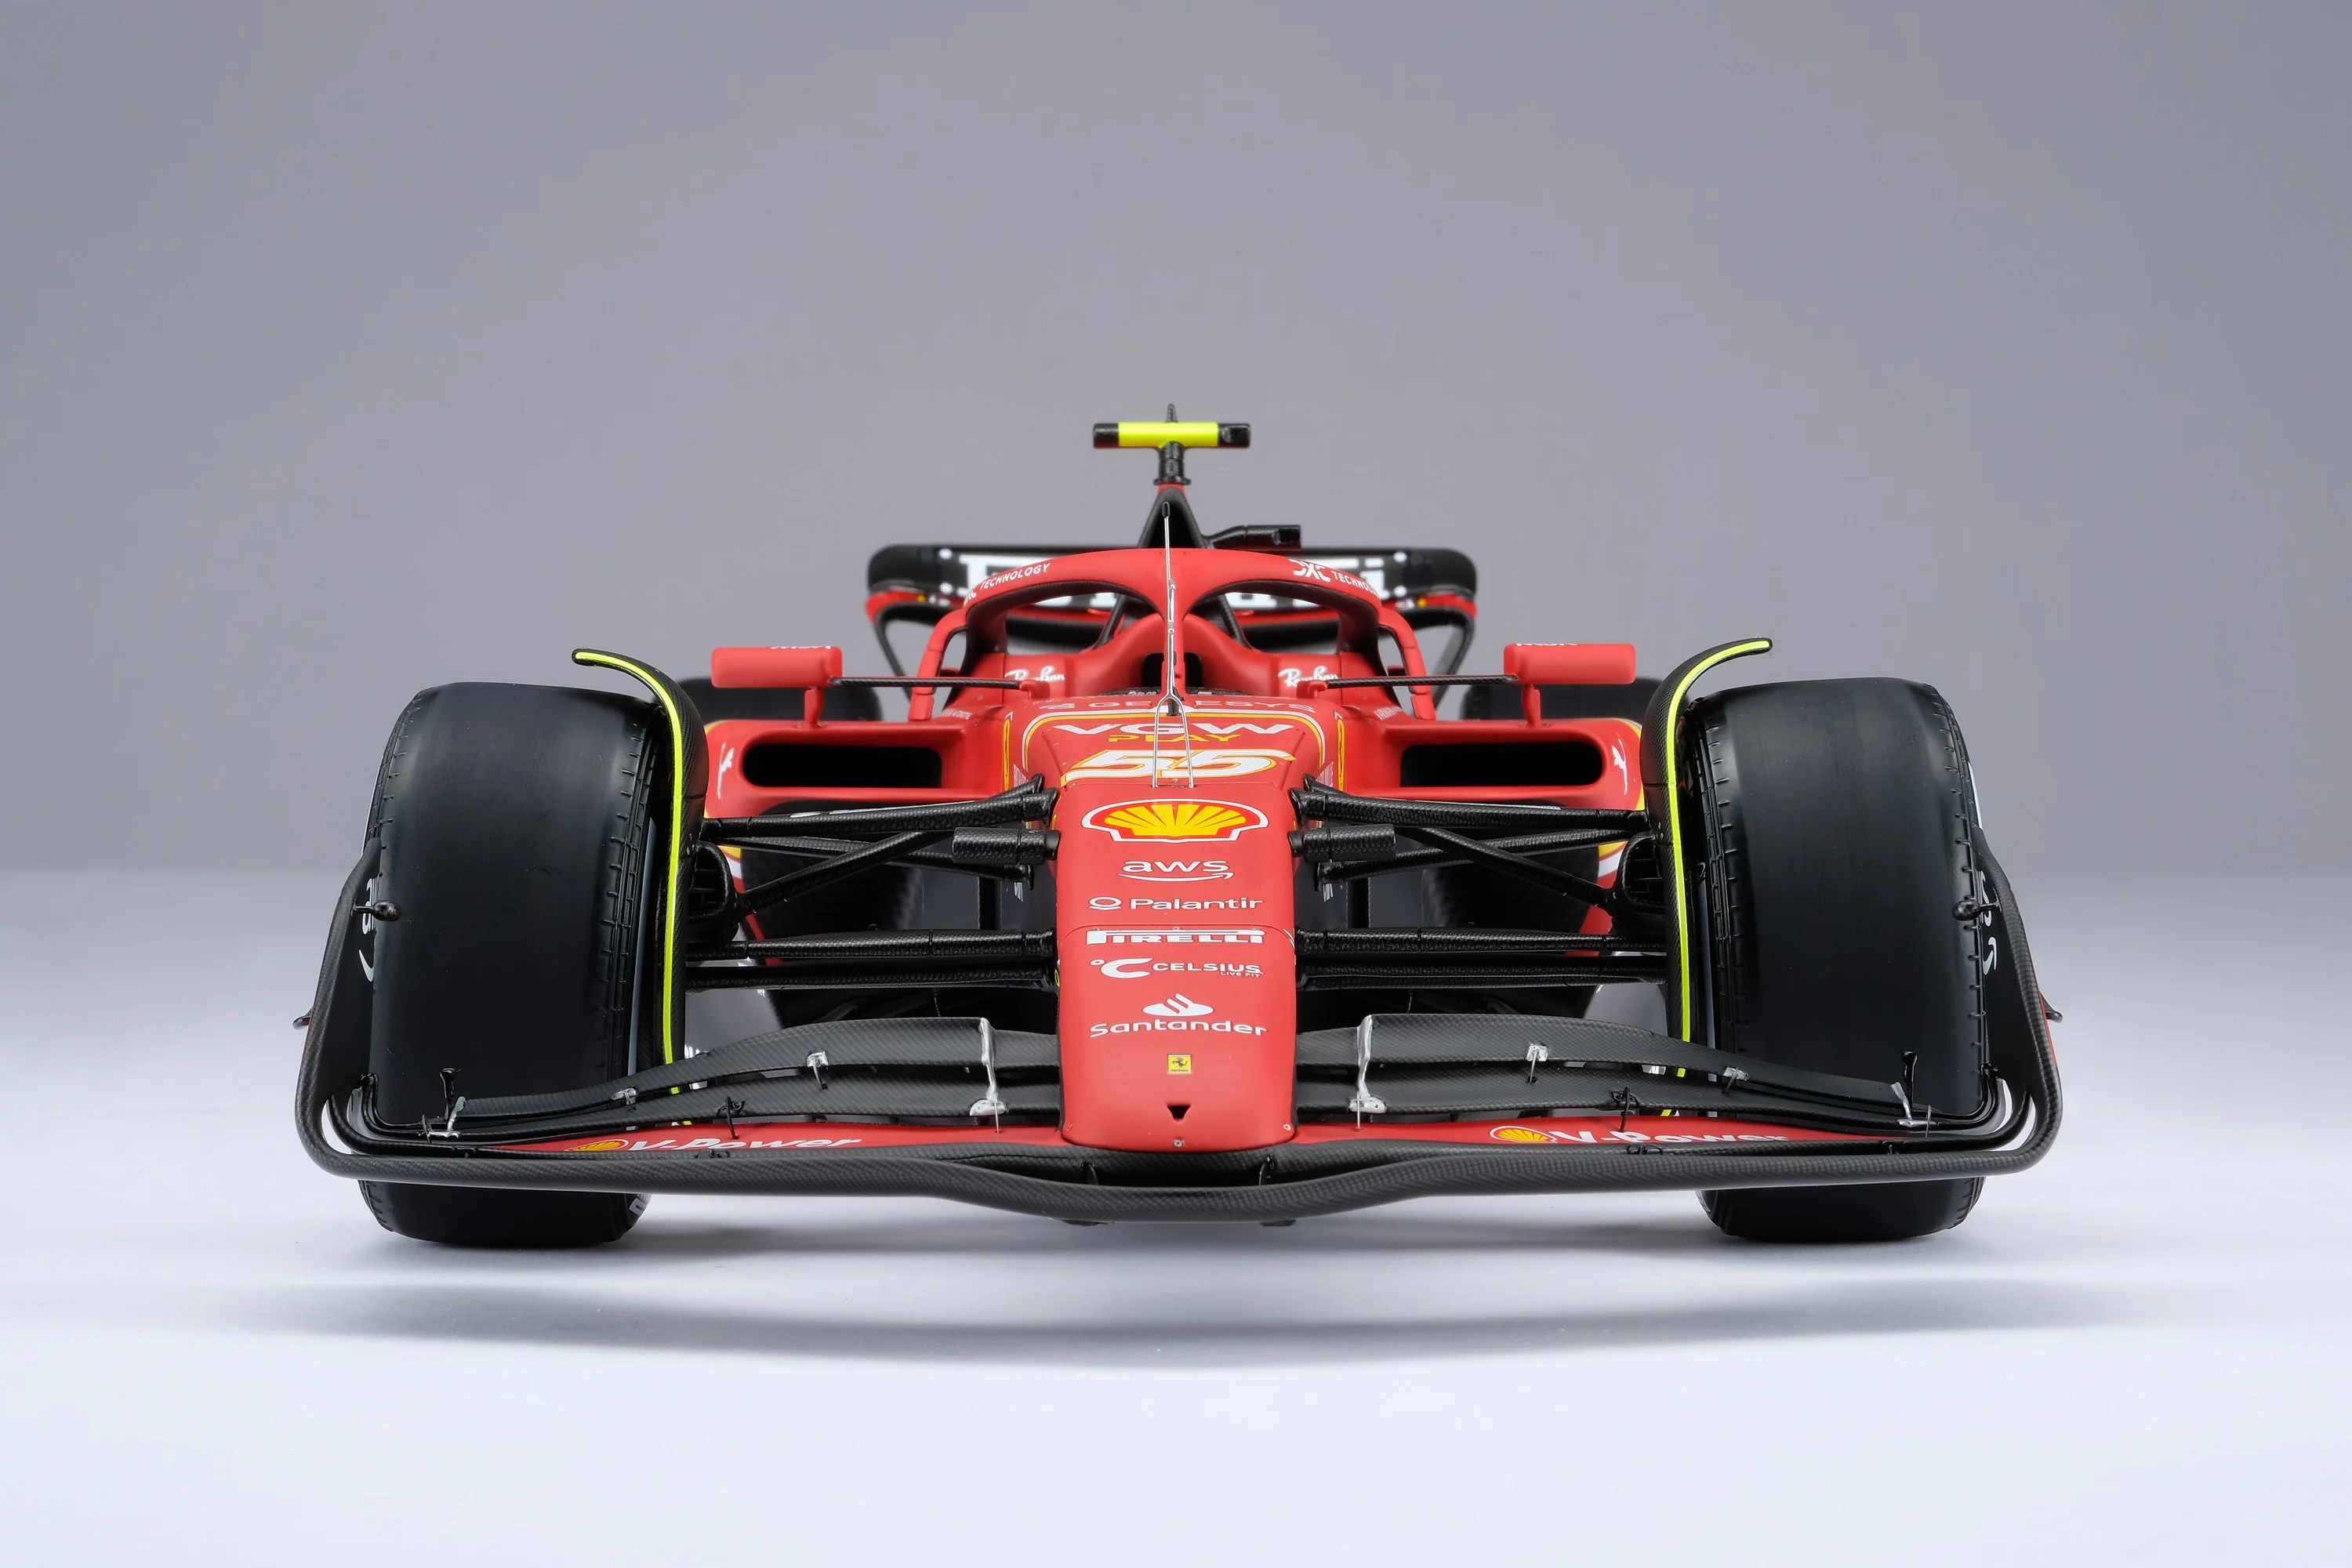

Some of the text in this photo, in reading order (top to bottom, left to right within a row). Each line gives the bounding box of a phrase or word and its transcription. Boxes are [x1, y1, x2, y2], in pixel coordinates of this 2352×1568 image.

[979, 562, 1051, 590] TECHNOLOGY
[1051, 723, 1294, 735] VGW
[1108, 734, 1242, 742] PLAY
[1060, 748, 1298, 787] 55
[1122, 859, 1229, 873] aws
[1130, 897, 1263, 910] Palantir
[1086, 929, 1265, 946] PIRELLI
[1152, 962, 1261, 973] CELSIUS
[1090, 1020, 1267, 1038] Santander
[1548, 1131, 1789, 1144] V-Power
[628, 1138, 863, 1151] V-Power
